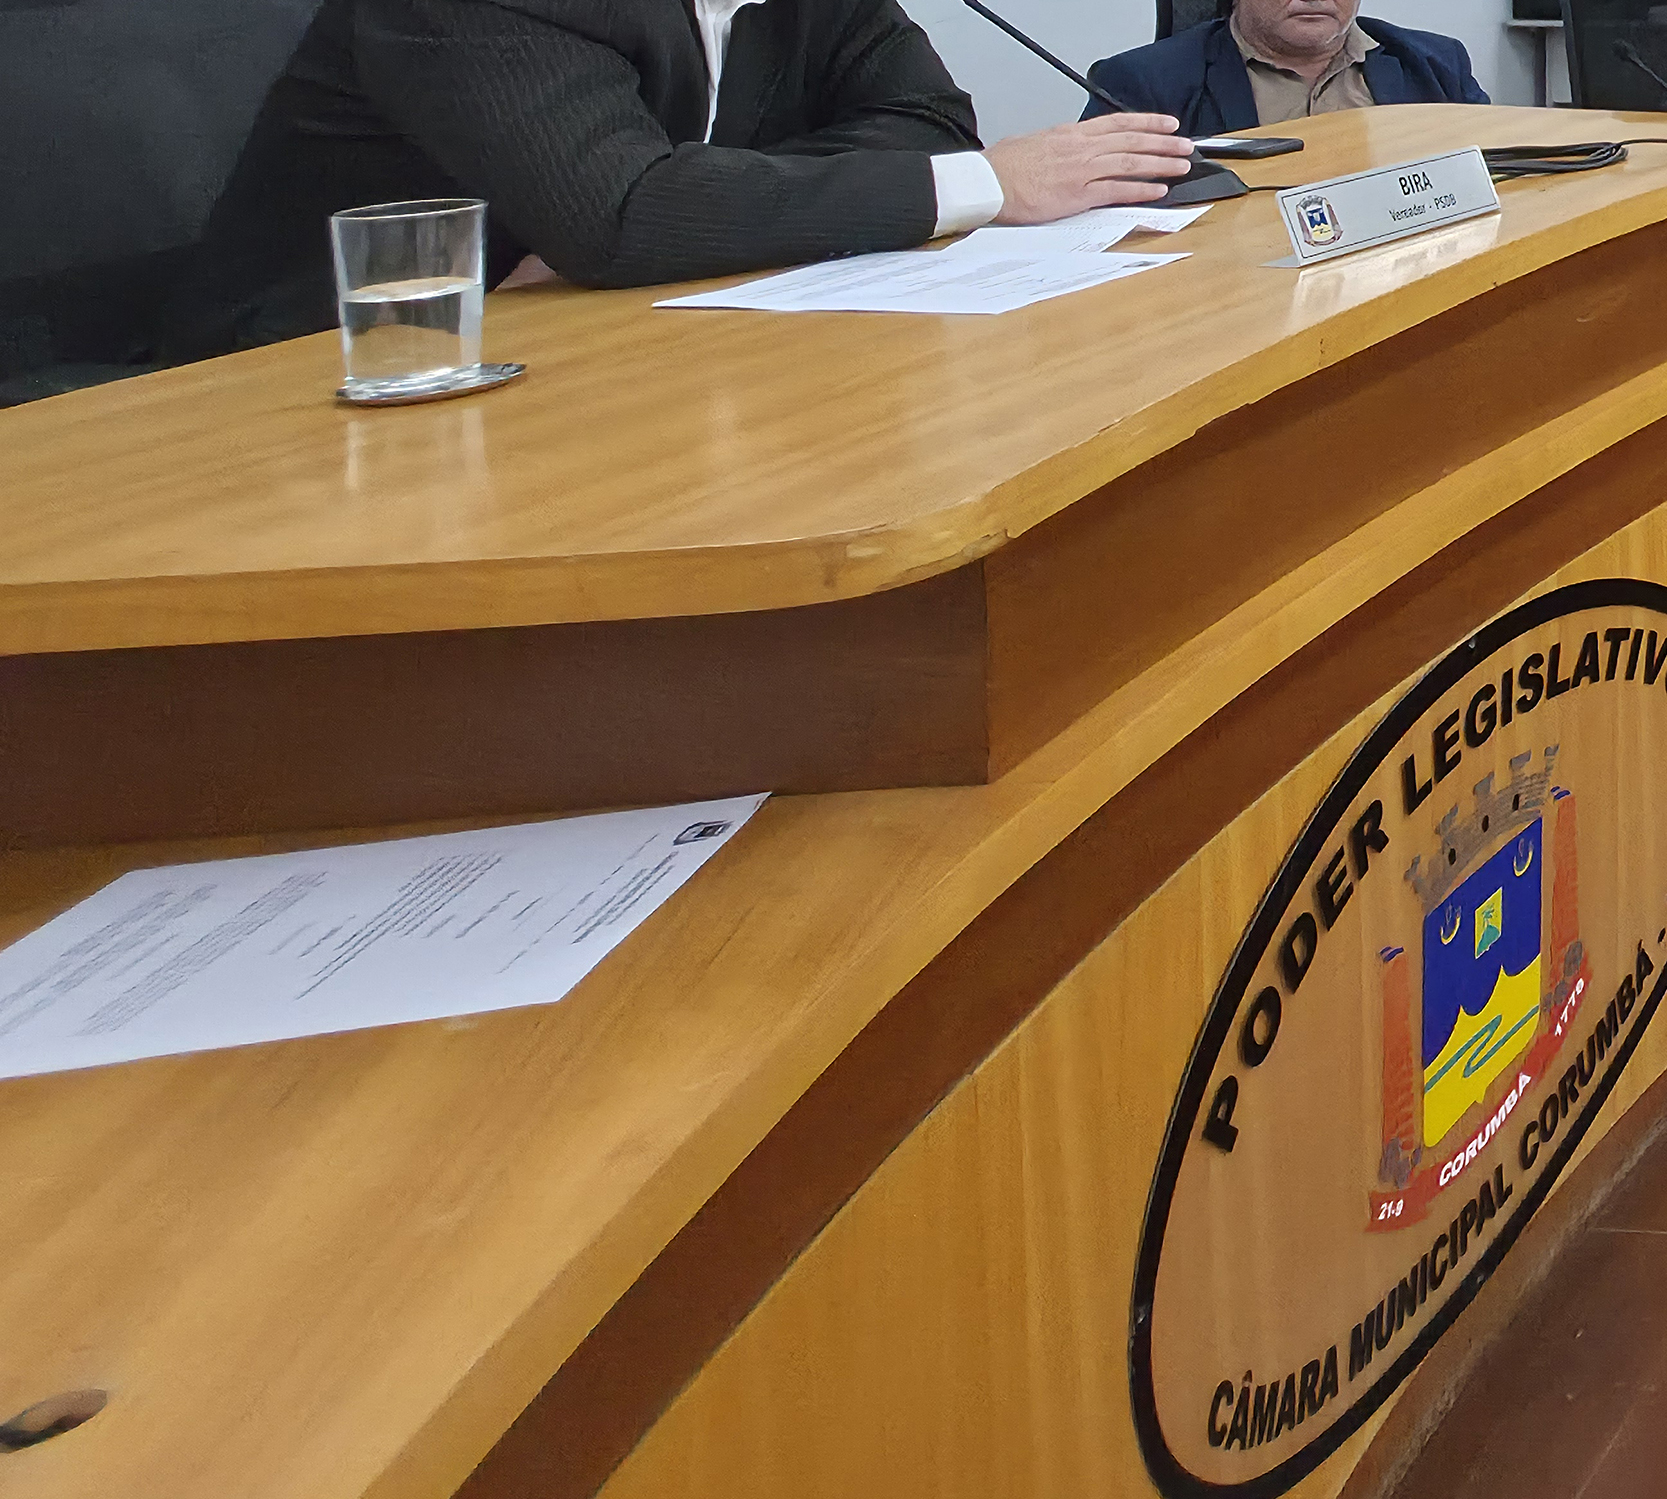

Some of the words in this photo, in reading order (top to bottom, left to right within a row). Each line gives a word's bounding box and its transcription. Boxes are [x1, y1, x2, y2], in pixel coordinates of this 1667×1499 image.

[1398, 171, 1433, 196] BIRA
[1434, 193, 1457, 210] PSDB
[1203, 798, 1389, 1153] PODER
[1207, 1370, 1338, 1451] CÂMARA
[1349, 1163, 1513, 1382] MUNICIPAL
[1520, 938, 1655, 1171] CORUMBÁ
